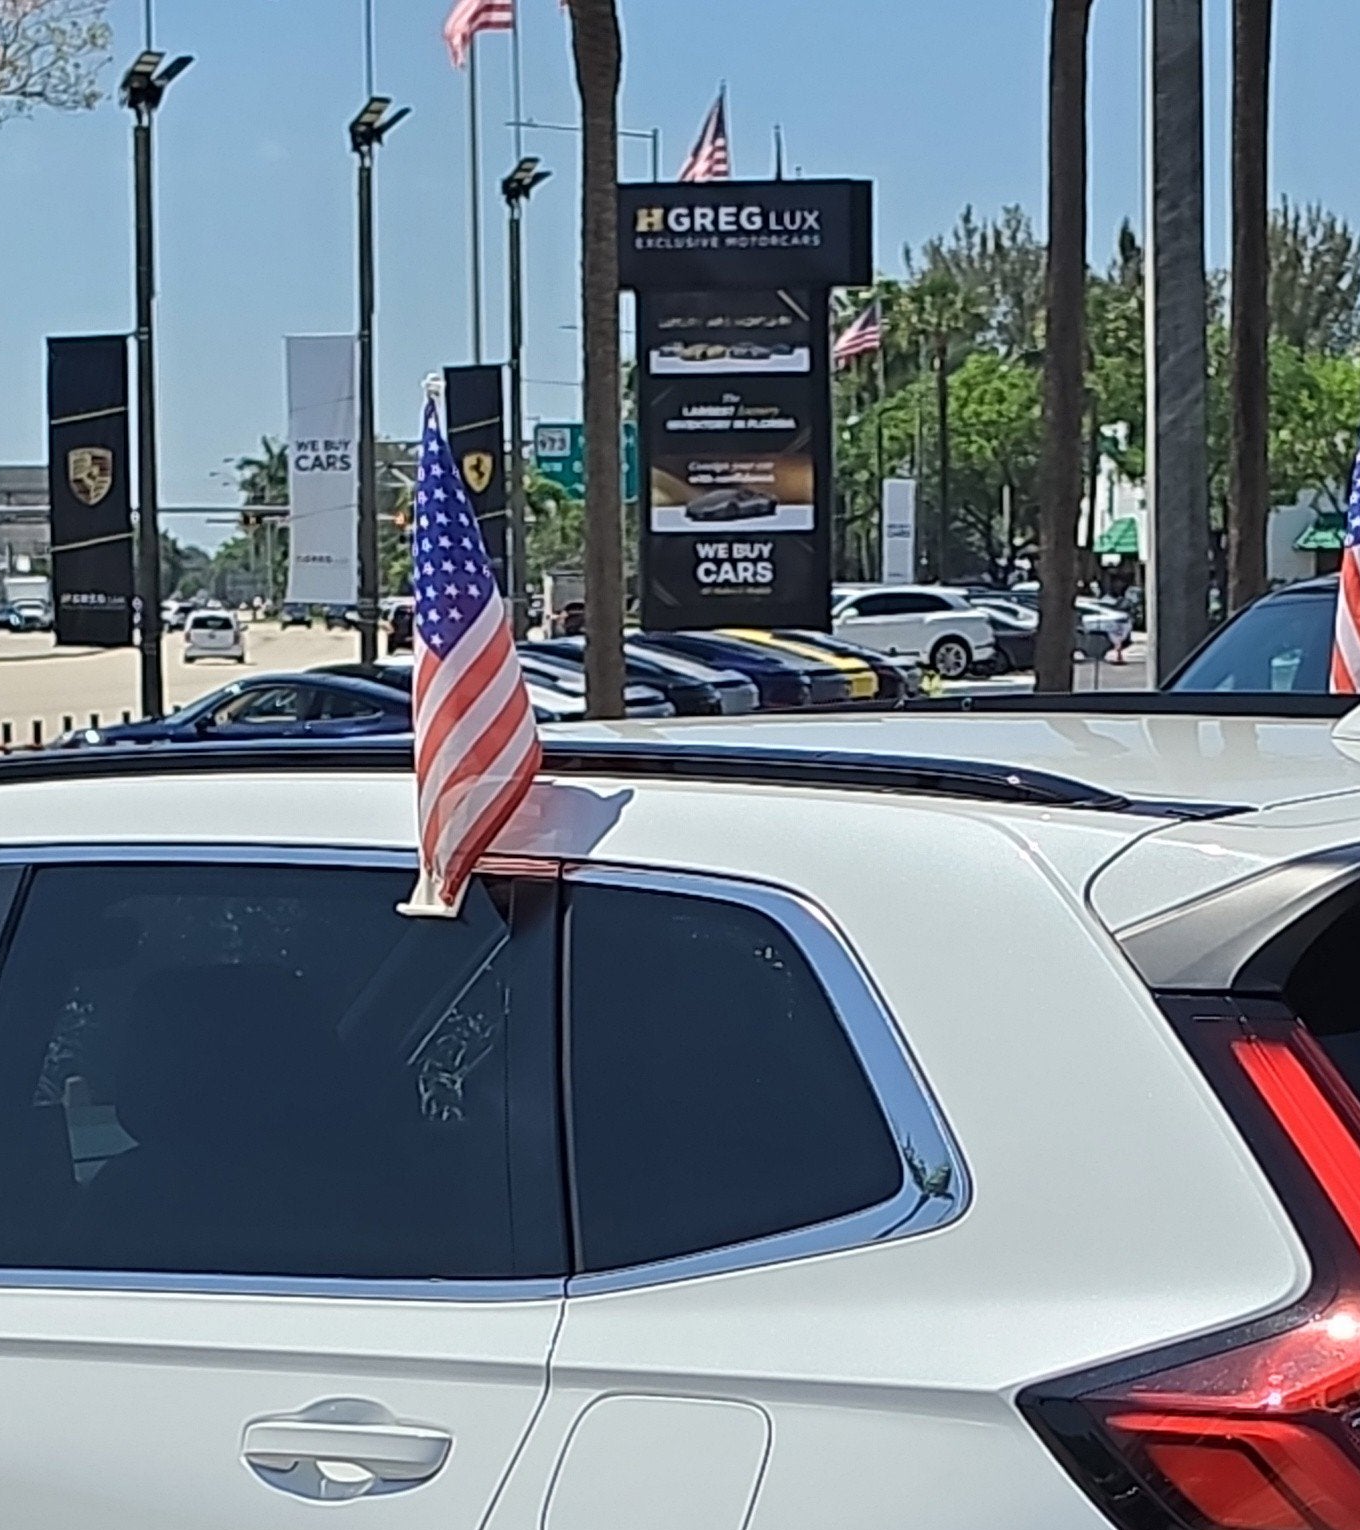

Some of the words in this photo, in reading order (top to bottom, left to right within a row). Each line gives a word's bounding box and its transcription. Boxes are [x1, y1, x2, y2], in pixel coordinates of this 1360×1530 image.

[635, 206, 763, 232] HGREG
[769, 210, 820, 230] LUX
[295, 454, 352, 471] CARS
[696, 543, 729, 558] WE
[733, 543, 773, 558] BUY
[697, 562, 774, 583] CARS
